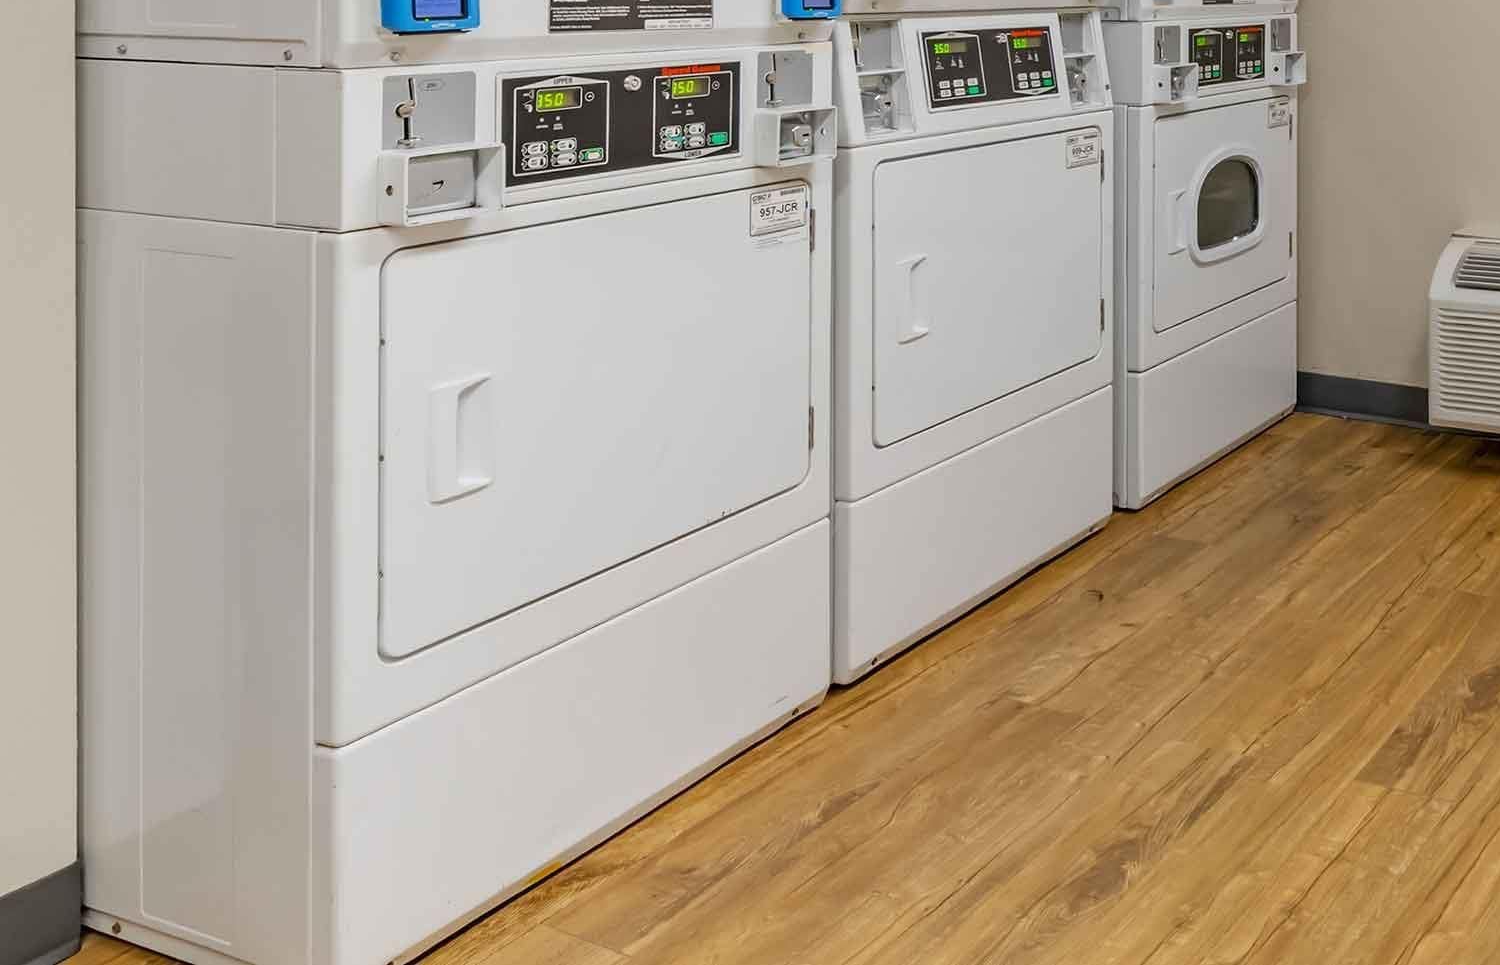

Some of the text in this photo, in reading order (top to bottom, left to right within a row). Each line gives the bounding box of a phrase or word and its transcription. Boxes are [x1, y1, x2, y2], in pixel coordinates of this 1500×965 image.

[553, 77, 573, 85] UPPER
[684, 149, 703, 158] LOWER
[759, 202, 798, 218] 957-JCR
